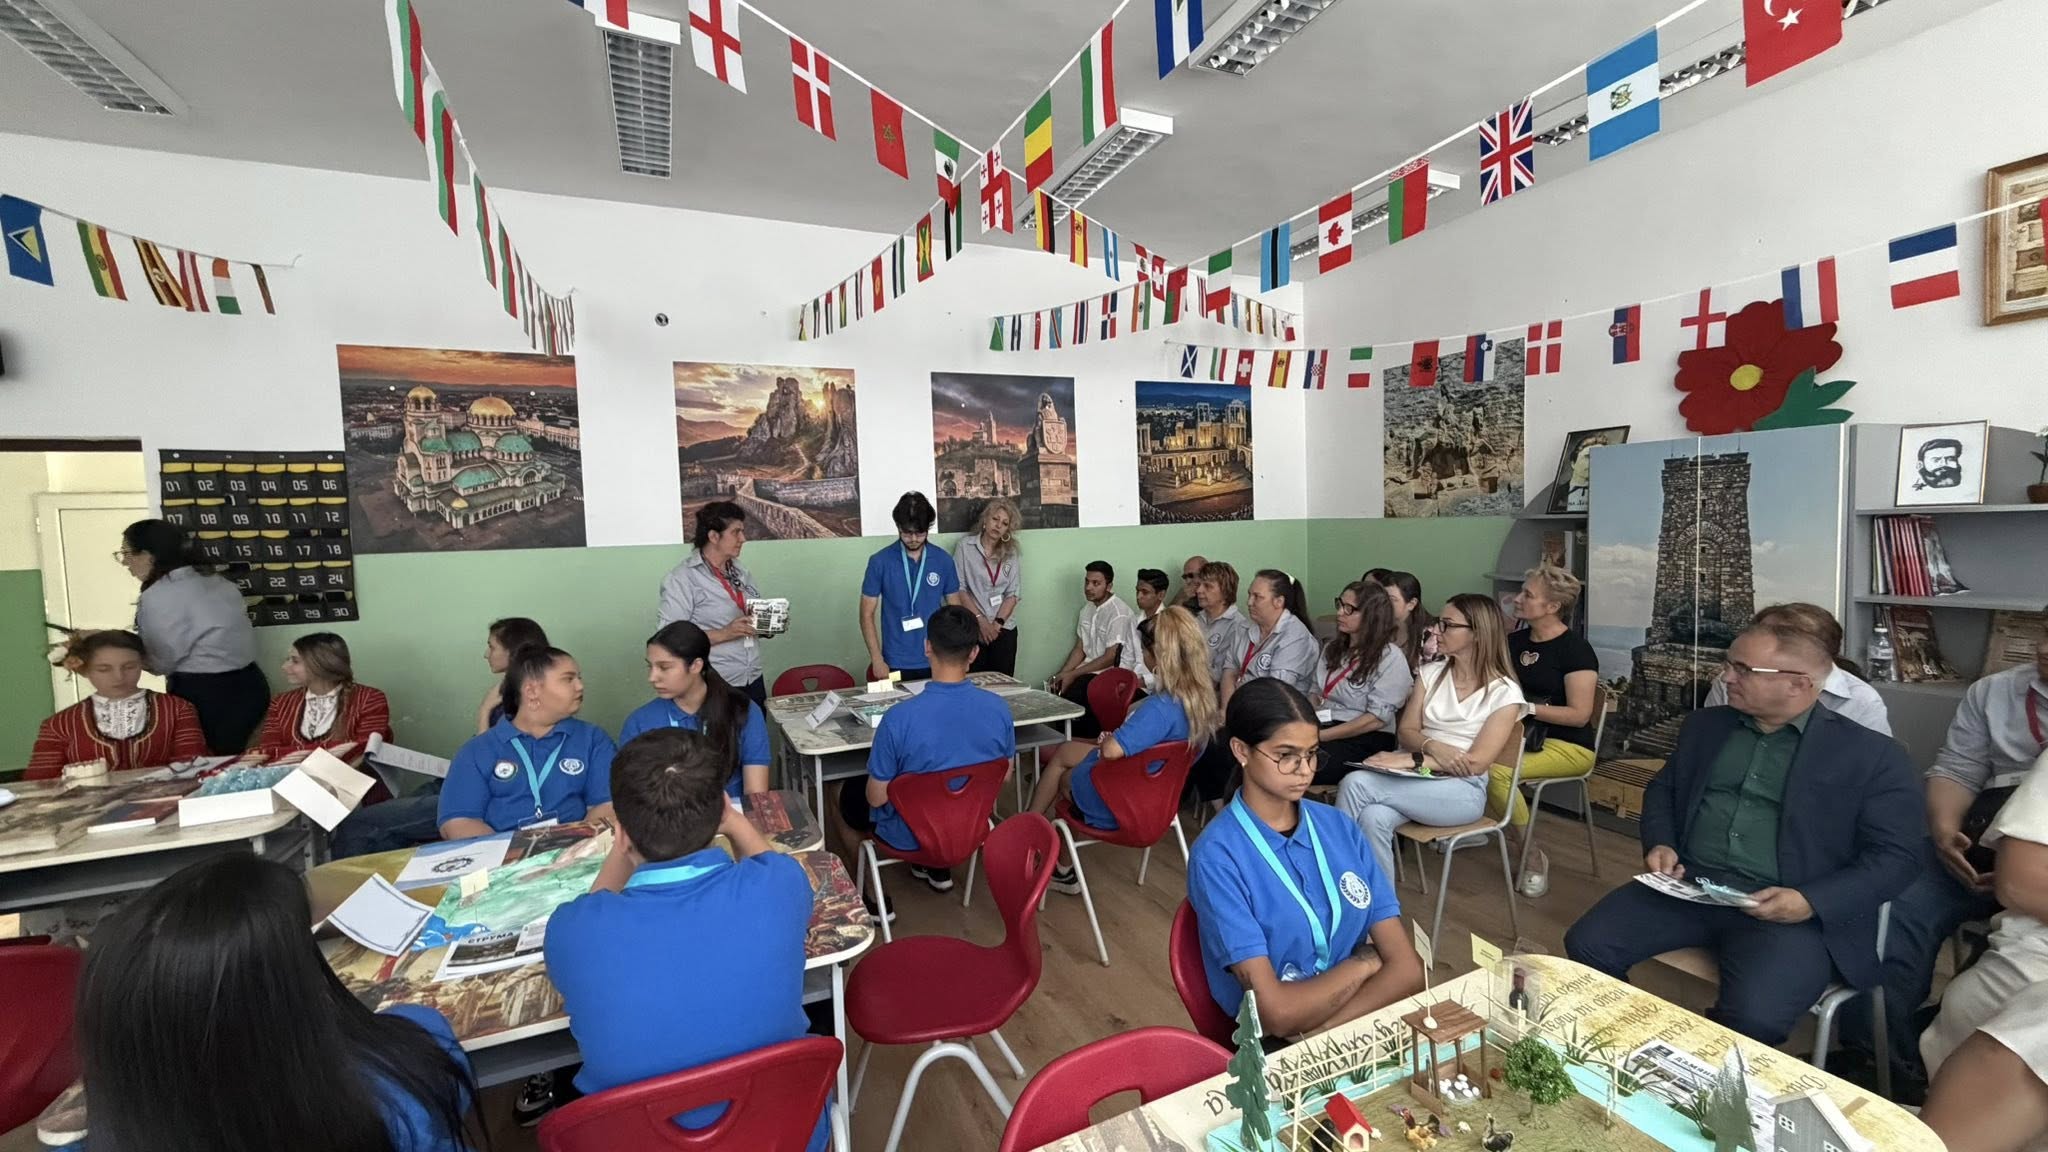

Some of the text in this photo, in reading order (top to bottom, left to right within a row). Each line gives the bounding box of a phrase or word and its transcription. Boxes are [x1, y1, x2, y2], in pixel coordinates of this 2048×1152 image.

[165, 479, 337, 492] 01 02 03 04 05 06
[167, 511, 340, 525] 07 08 09 10 11 12
[204, 544, 342, 556] 14 15 16 17 18
[269, 577, 286, 587] 22
[299, 575, 316, 586] 23
[328, 574, 344, 585] 24
[273, 611, 290, 620] 28
[304, 609, 321, 619] 29
[333, 607, 349, 617] 30
[468, 931, 514, 944] СТРУМА
[1593, 988, 1629, 1007] нещо
